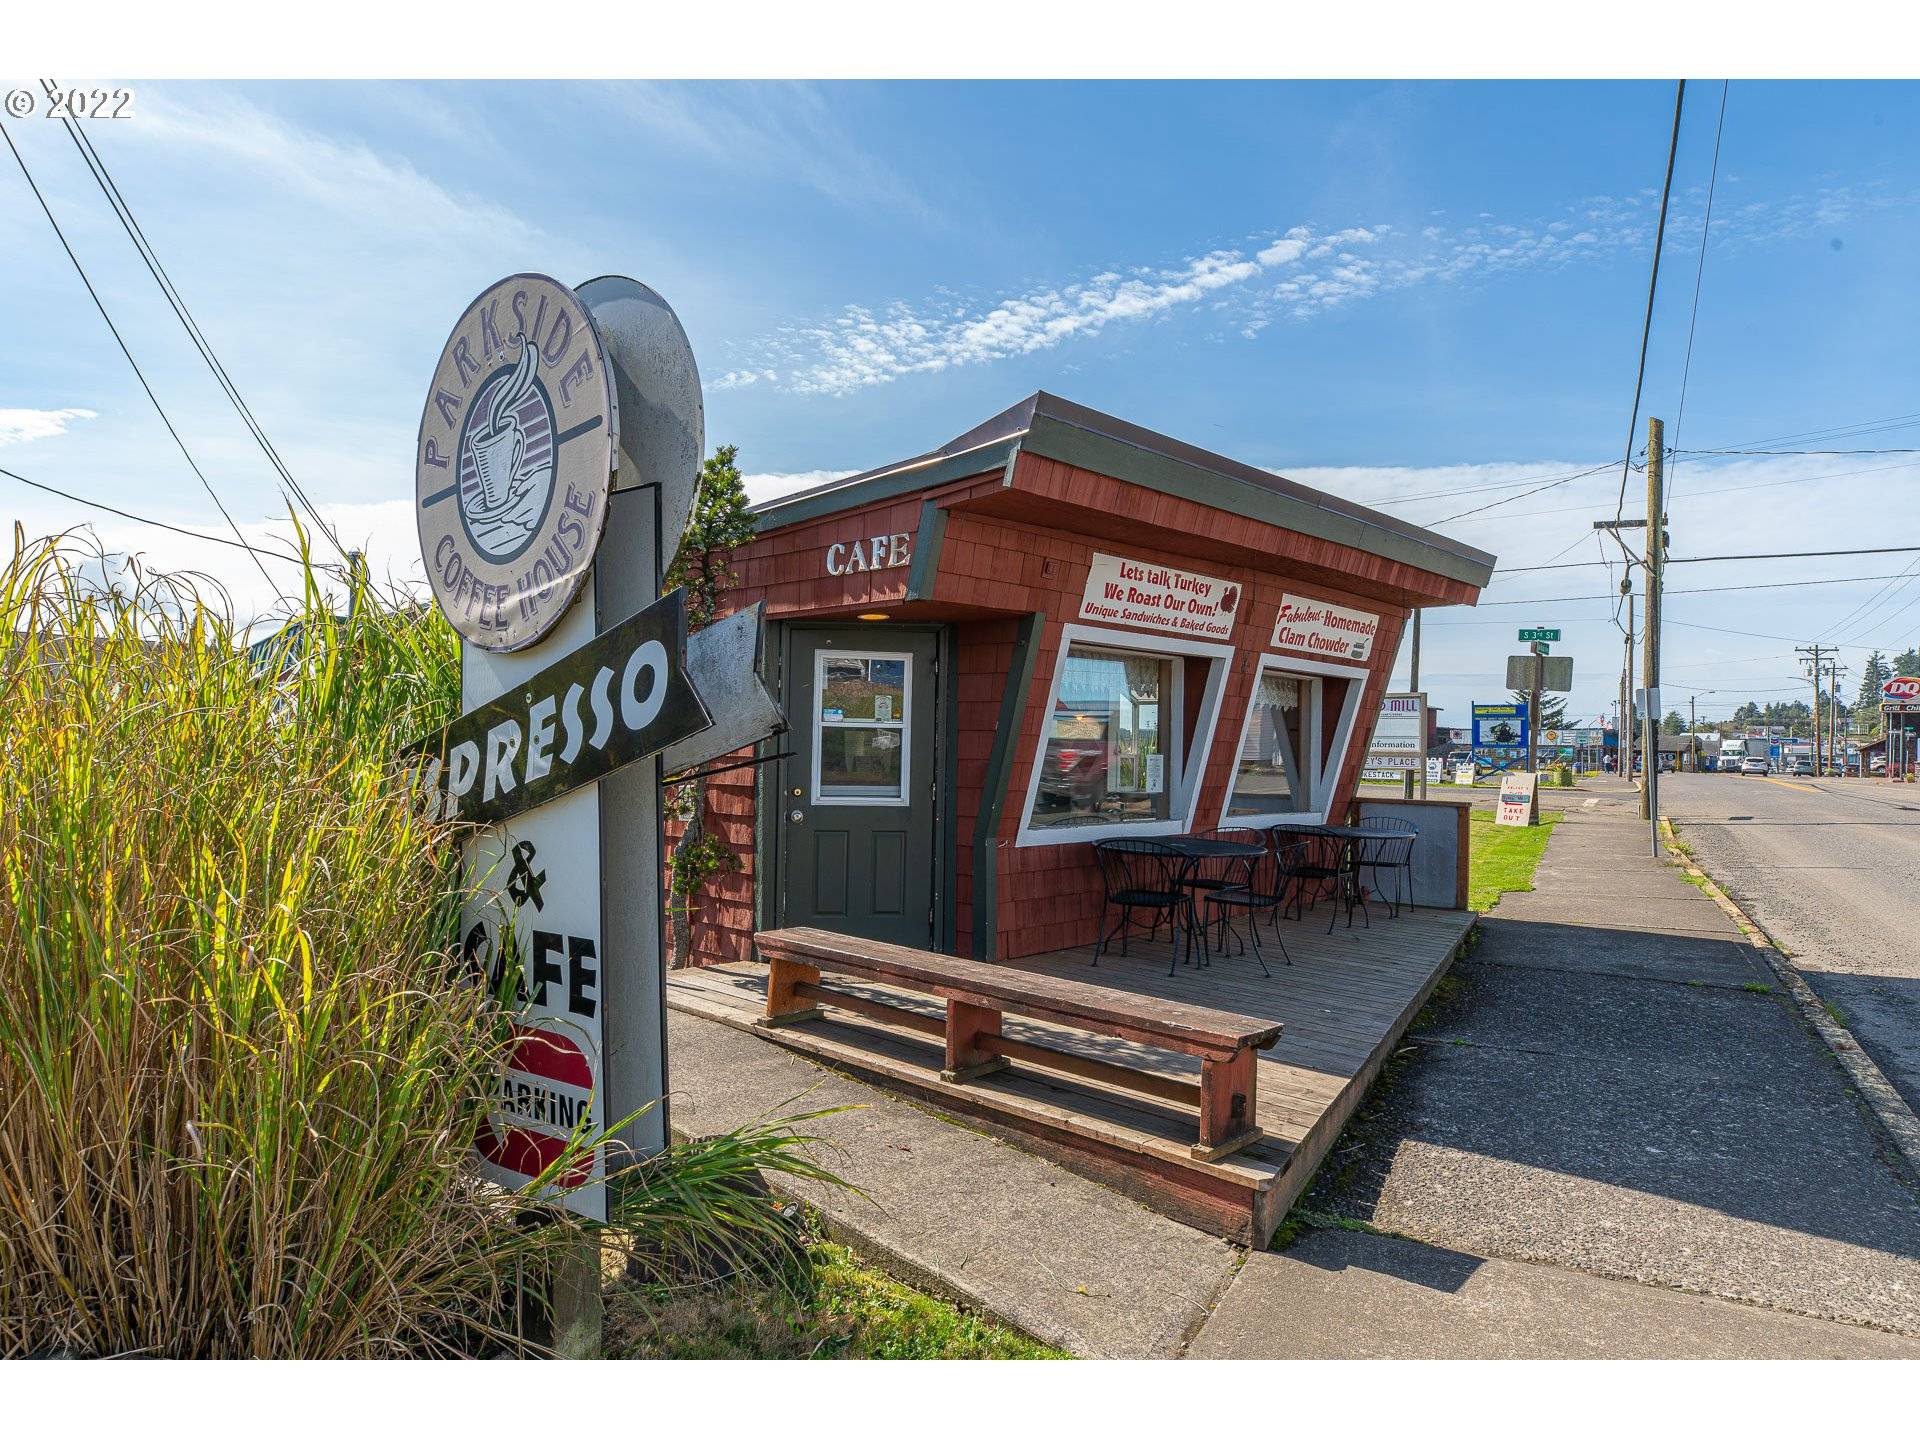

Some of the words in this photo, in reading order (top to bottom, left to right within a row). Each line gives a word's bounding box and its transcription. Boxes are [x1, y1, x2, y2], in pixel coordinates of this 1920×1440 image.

[424, 290, 594, 470] PARKSIDE
[434, 533, 512, 632] COFFEE
[515, 480, 595, 622] HOUSE
[826, 531, 912, 577] CAFE
[1120, 562, 1144, 581] Lets
[1147, 569, 1171, 590] talk
[1175, 573, 1212, 597] Turkey
[1104, 582, 1124, 601] We
[1126, 586, 1161, 608] Roast
[1163, 594, 1186, 612] Our
[1187, 600, 1219, 617] Own!
[1085, 602, 1119, 619] Unique
[1120, 608, 1170, 626] Sandwiches
[1171, 616, 1178, 627] &
[1179, 617, 1204, 632] Baked
[1205, 622, 1229, 635] Goods
[1277, 604, 1321, 625] Fabulous
[1323, 609, 1376, 636] Homemade
[1524, 631, 1529, 639] S
[1532, 631, 1543, 639] 3rd
[1545, 631, 1554, 639] St
[1278, 626, 1306, 646] Clam
[1307, 632, 1350, 654] Chowder
[1391, 700, 1417, 711] MILL
[1890, 682, 1919, 696] DQ
[1388, 758, 1416, 766] PLACE
[507, 840, 546, 912] &
